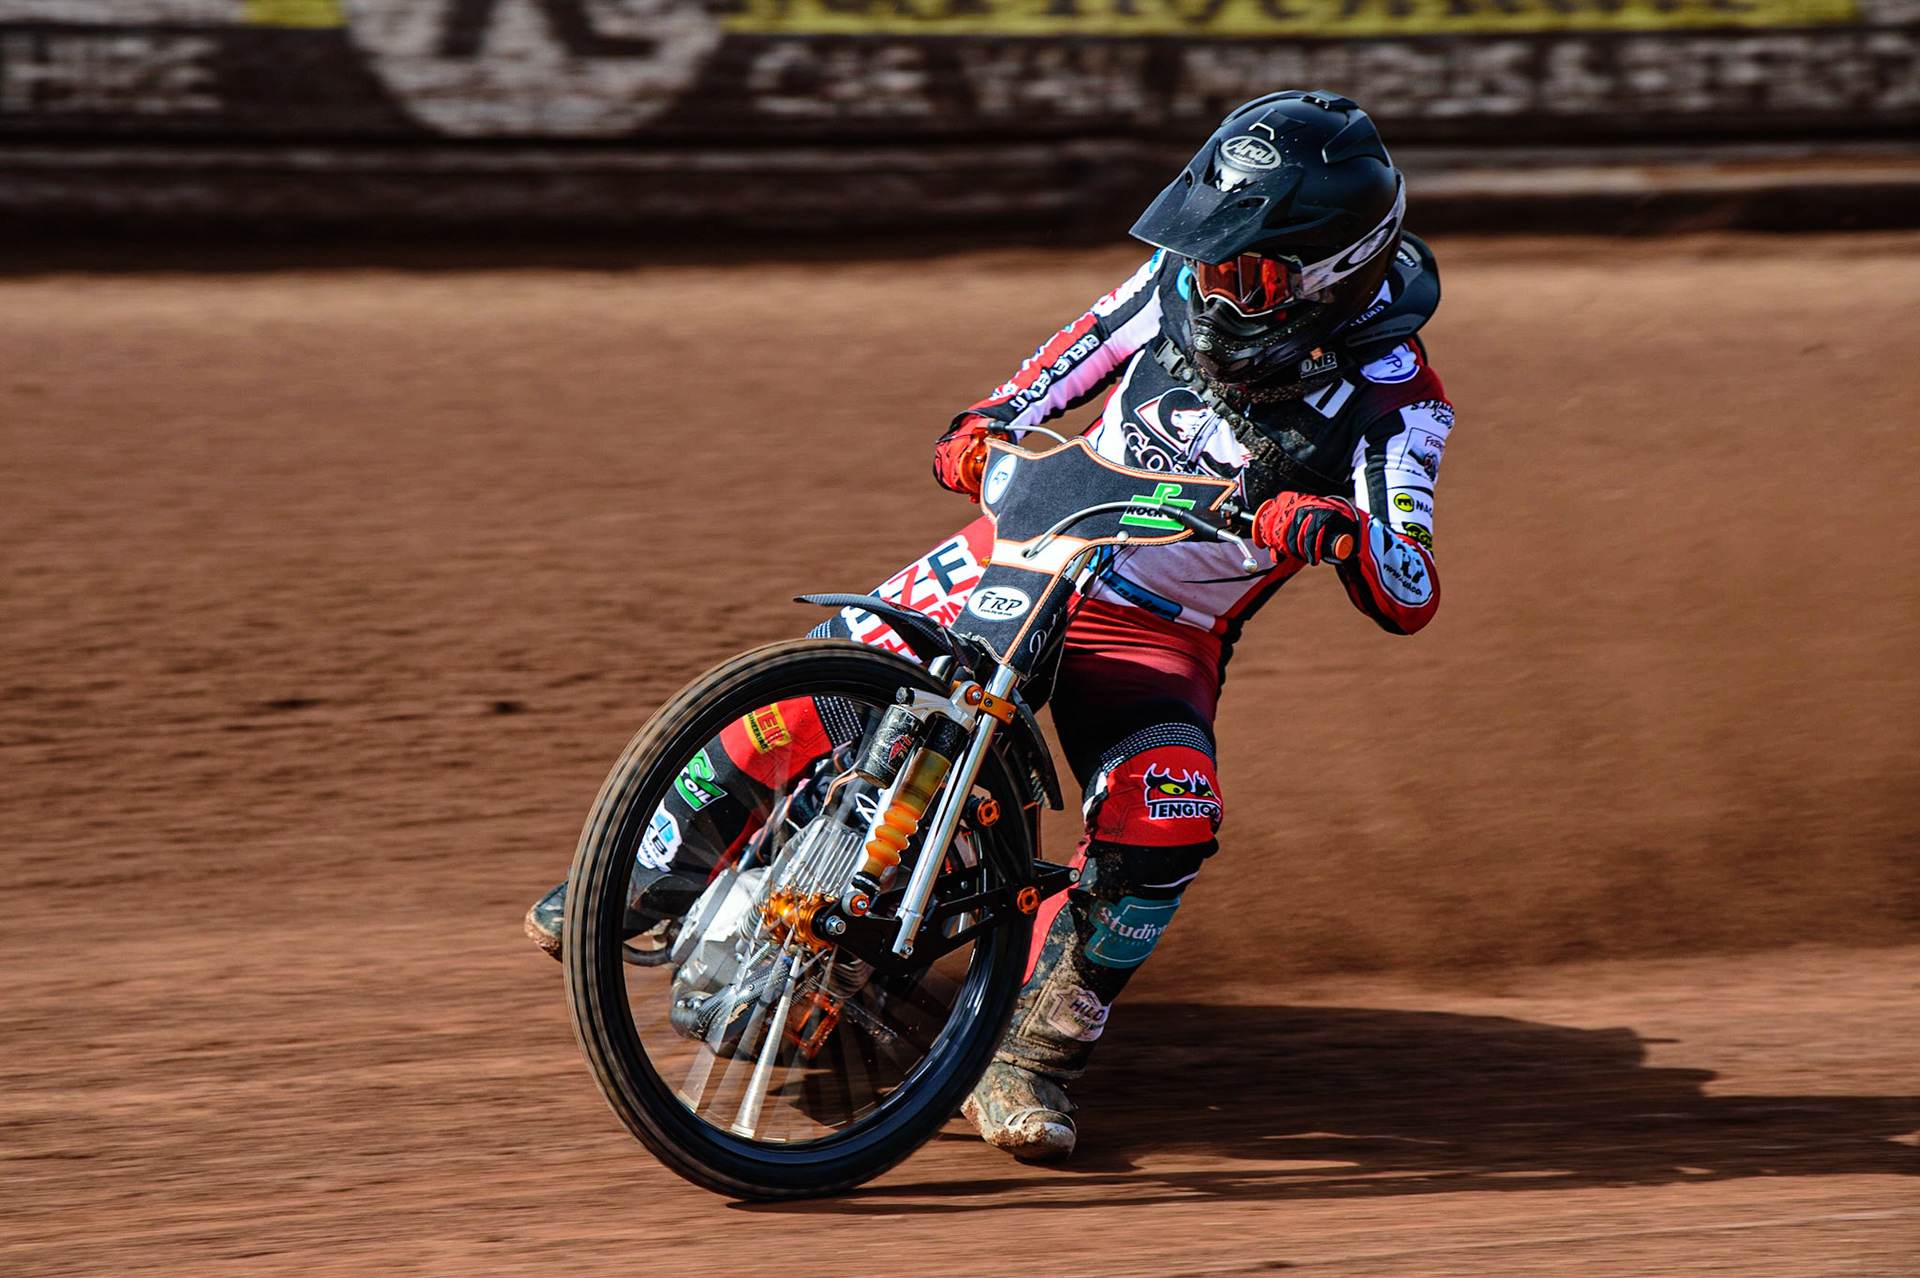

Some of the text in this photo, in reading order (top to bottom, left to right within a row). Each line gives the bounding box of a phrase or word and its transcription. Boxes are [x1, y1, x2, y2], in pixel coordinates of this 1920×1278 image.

[1226, 138, 1276, 164] Arai
[980, 590, 1023, 611] FRP
[685, 781, 711, 804] OIL
